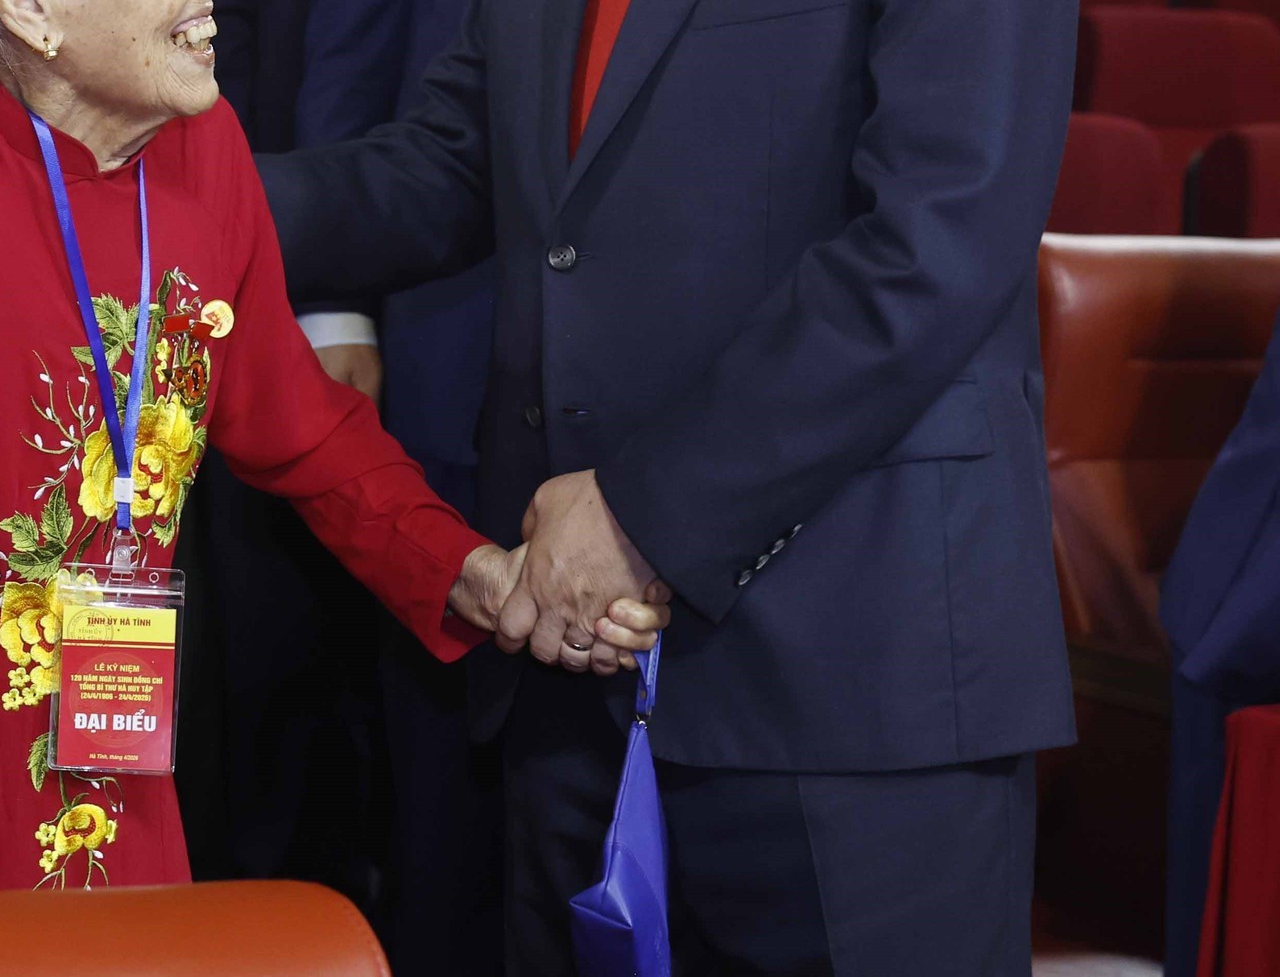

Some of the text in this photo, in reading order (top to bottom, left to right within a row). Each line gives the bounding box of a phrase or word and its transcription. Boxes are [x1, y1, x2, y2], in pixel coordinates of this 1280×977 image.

[87, 614, 151, 626] TỈNH ỦY HÀ TĨNH
[94, 662, 140, 674] LỄ KỶ NIỆM
[83, 674, 98, 682] NĂM
[99, 674, 116, 682] NGÀY
[152, 676, 163, 684] CHÍ
[97, 683, 104, 691] BÍ
[141, 684, 154, 694] TẬP
[74, 709, 157, 733] ĐẠI BIỂU
